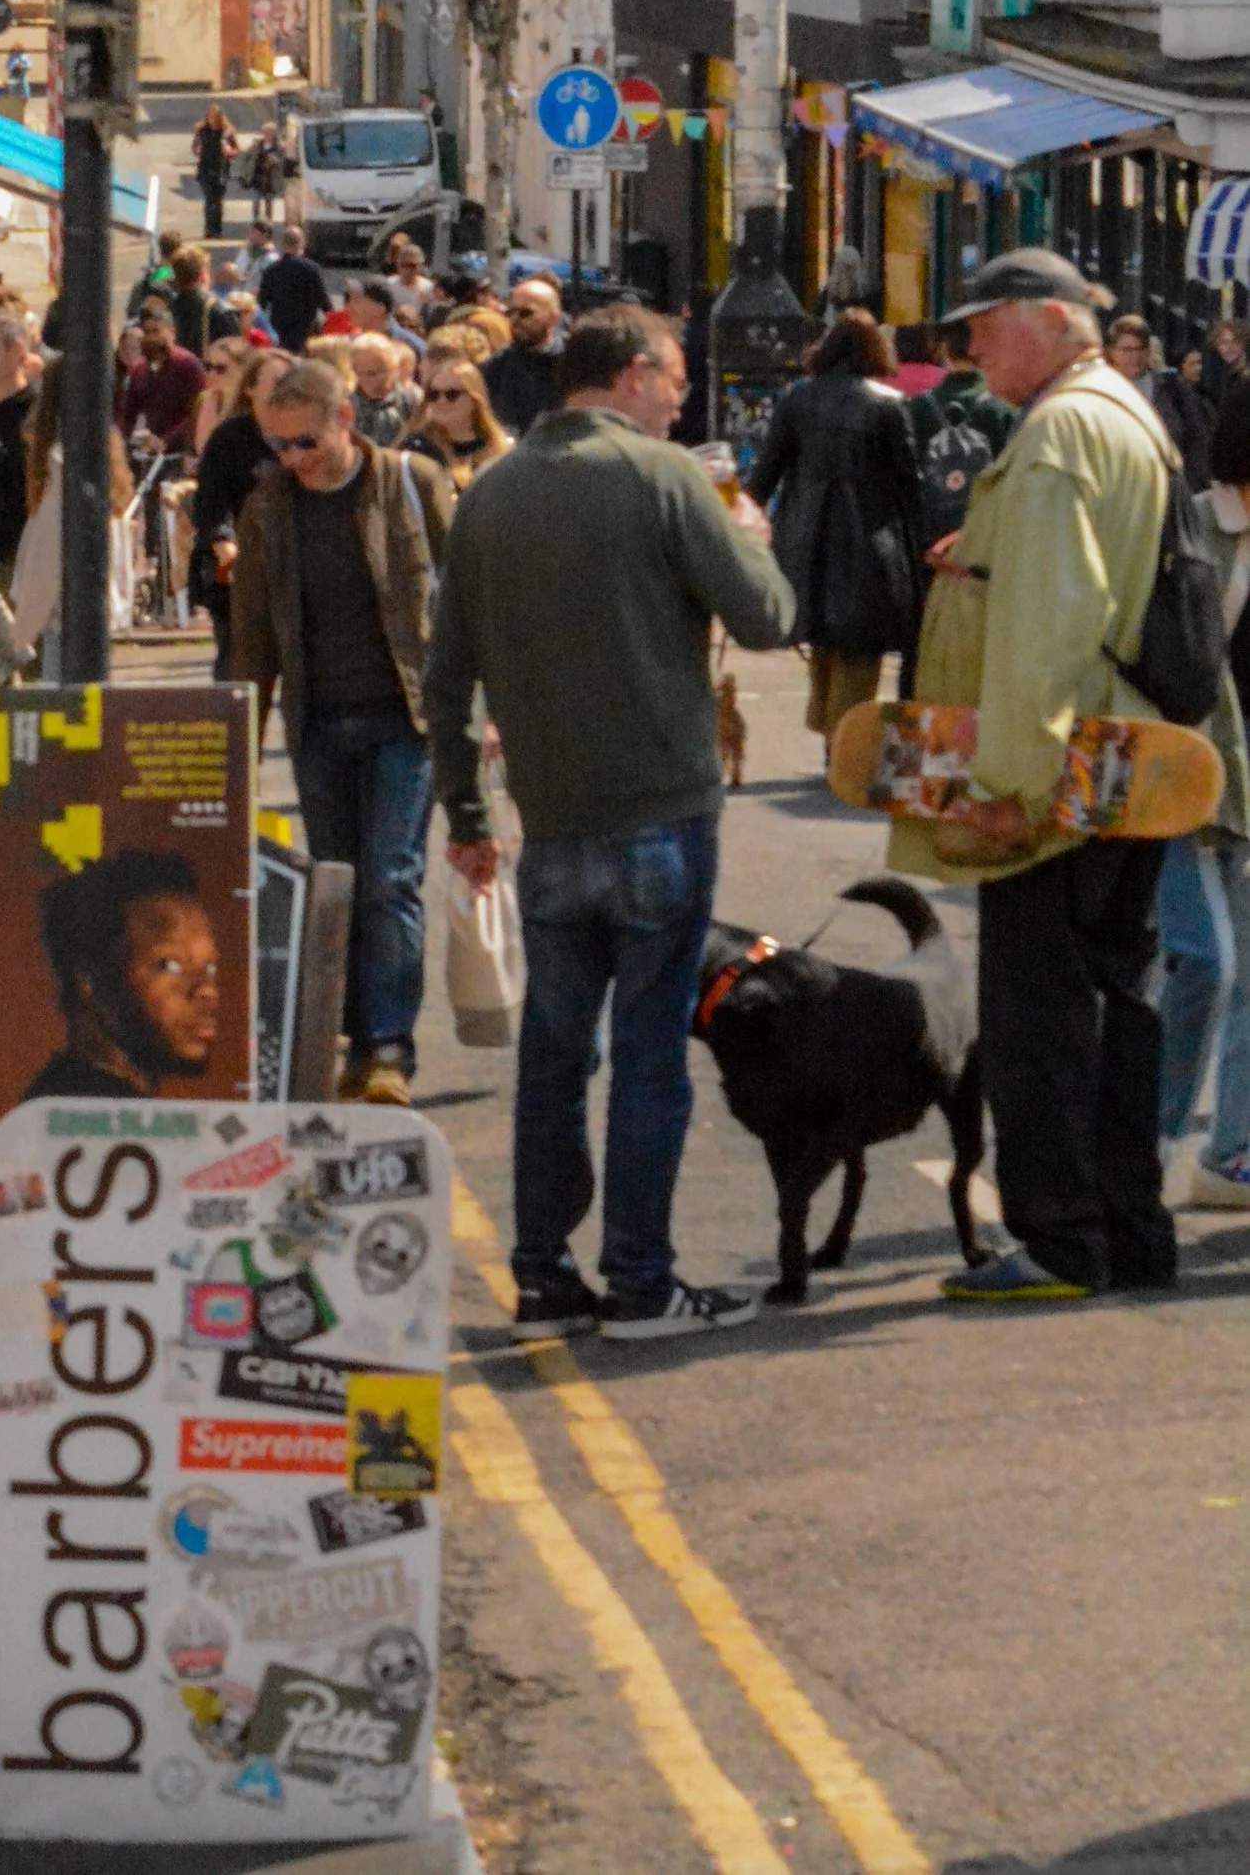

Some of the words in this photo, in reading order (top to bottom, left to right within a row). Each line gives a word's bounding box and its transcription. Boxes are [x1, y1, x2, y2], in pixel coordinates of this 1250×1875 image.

[1, 1143, 161, 1775] barbers
[189, 1422, 347, 1469] Supreme
[277, 1680, 398, 1765] Patta
